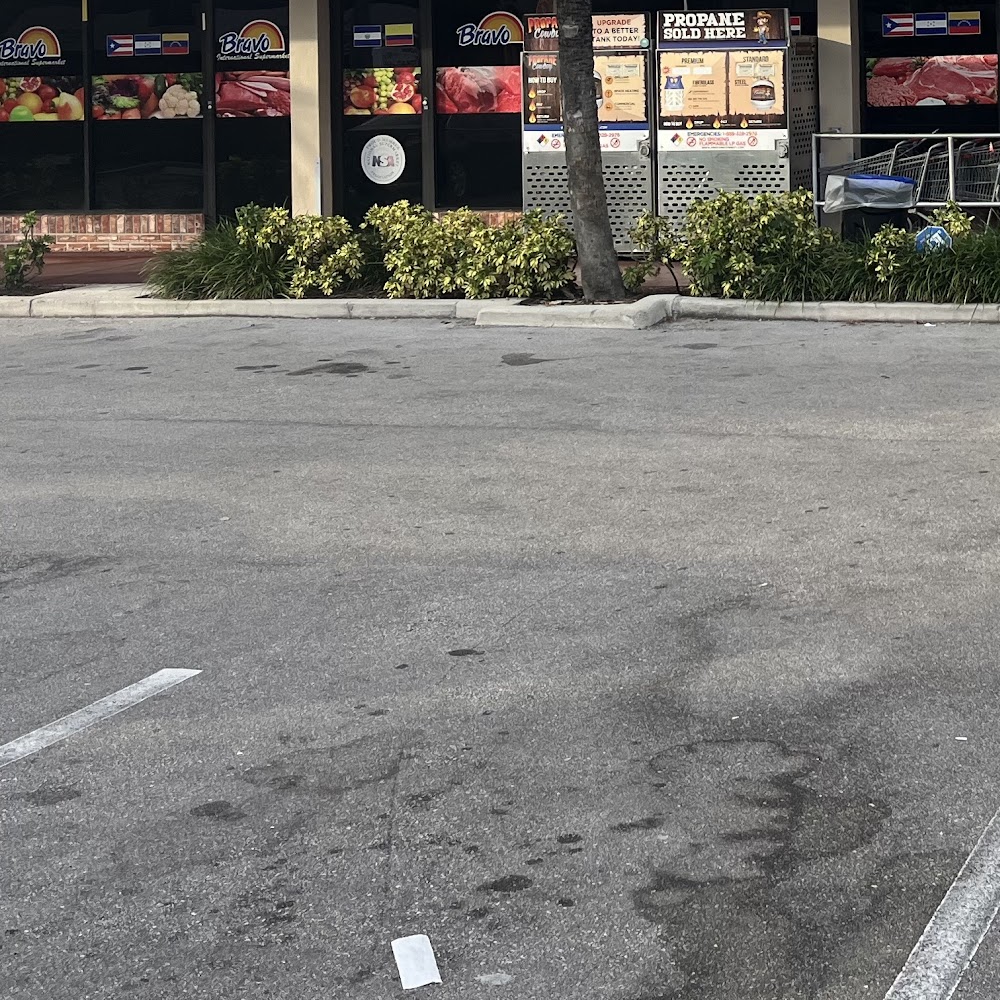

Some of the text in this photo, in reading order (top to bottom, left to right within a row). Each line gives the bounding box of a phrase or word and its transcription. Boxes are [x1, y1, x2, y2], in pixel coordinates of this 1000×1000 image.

[527, 17, 559, 33] PROPA
[663, 12, 745, 27] PROPANE
[456, 23, 512, 46] Bravo
[533, 28, 560, 39] Cowb
[663, 27, 747, 40] SOLD HERE
[0, 37, 47, 60] Bravo
[218, 32, 271, 54] Bravo
[216, 52, 290, 61] International Supermarket
[372, 156, 395, 167] NSA
